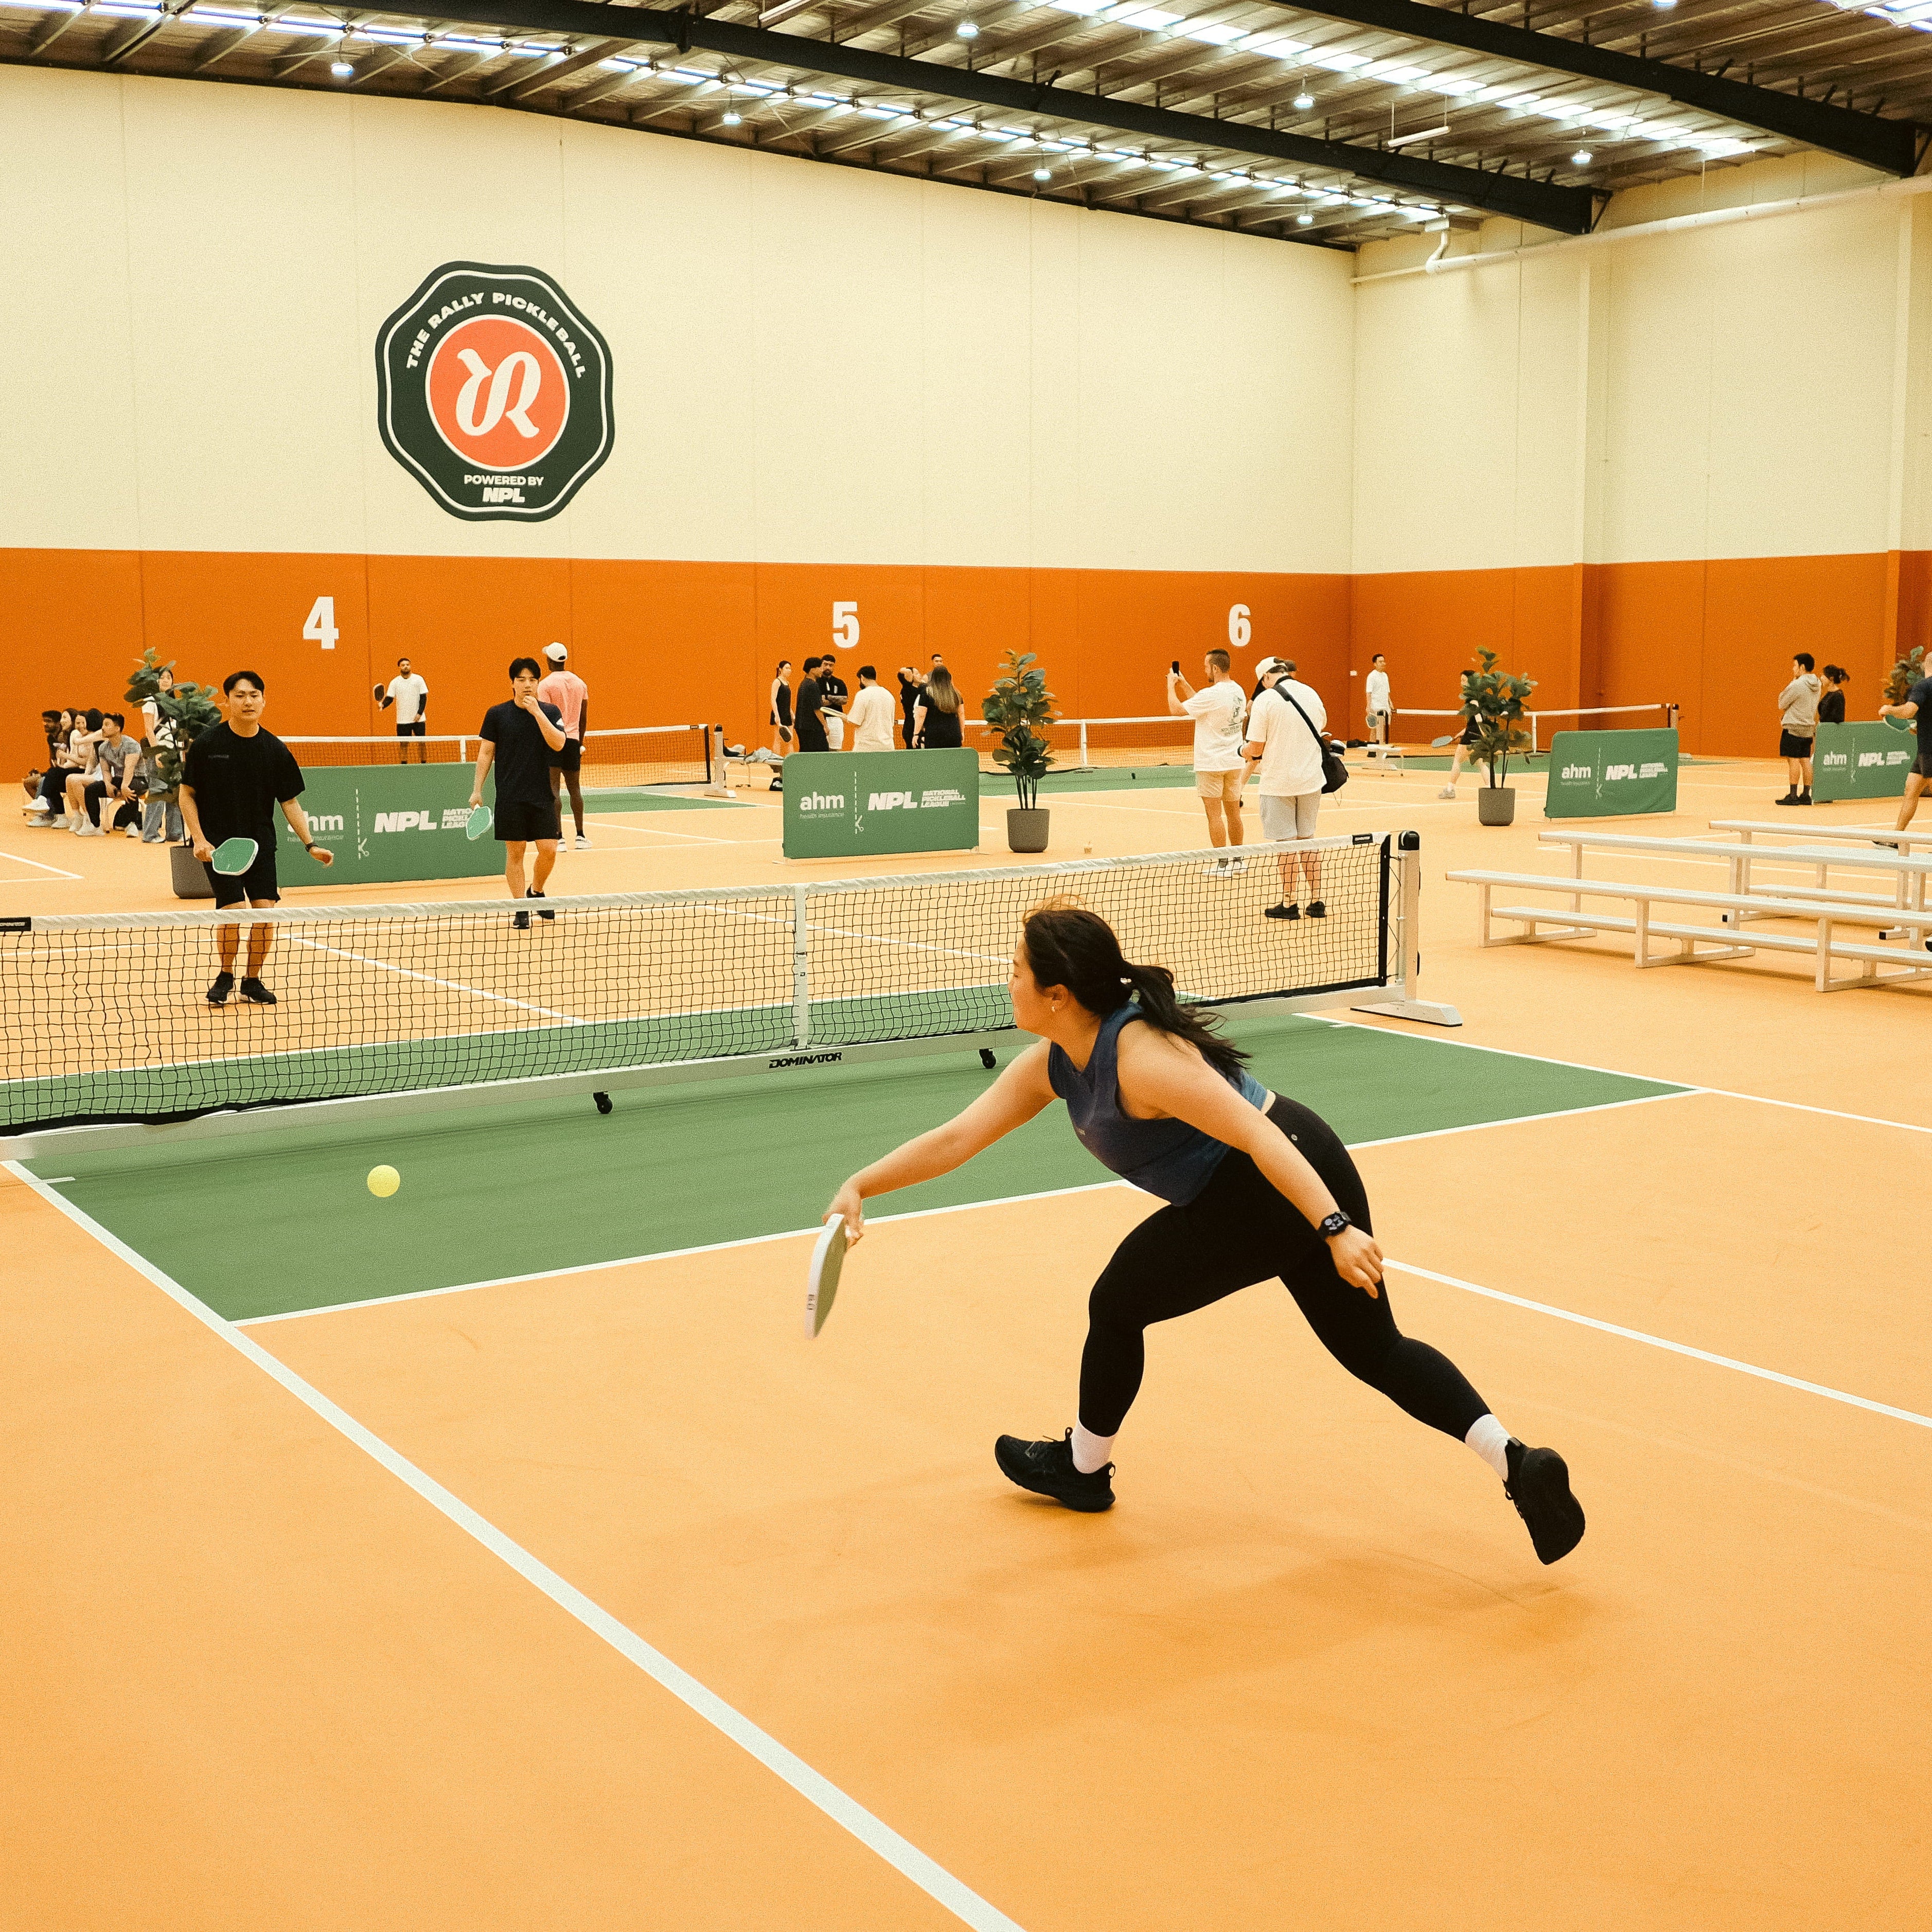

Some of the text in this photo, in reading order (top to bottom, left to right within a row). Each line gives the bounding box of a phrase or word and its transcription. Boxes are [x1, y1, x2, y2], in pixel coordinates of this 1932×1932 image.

[406, 292, 586, 378] THE RALLY PICKLEBALL
[464, 474, 544, 486] POWERED BY
[483, 487, 525, 503] NPL
[303, 596, 339, 649] 4
[833, 601, 860, 648] 5
[1229, 604, 1251, 647] 6
[1823, 751, 1847, 765] ahm
[1858, 752, 1885, 767] NPL
[1562, 764, 1591, 779] ahm
[1605, 764, 1637, 781] NPL
[800, 791, 844, 810] ahm
[867, 791, 917, 810] NPL
[374, 810, 437, 833] NPL
[769, 1052, 842, 1069] DOMINATOR
